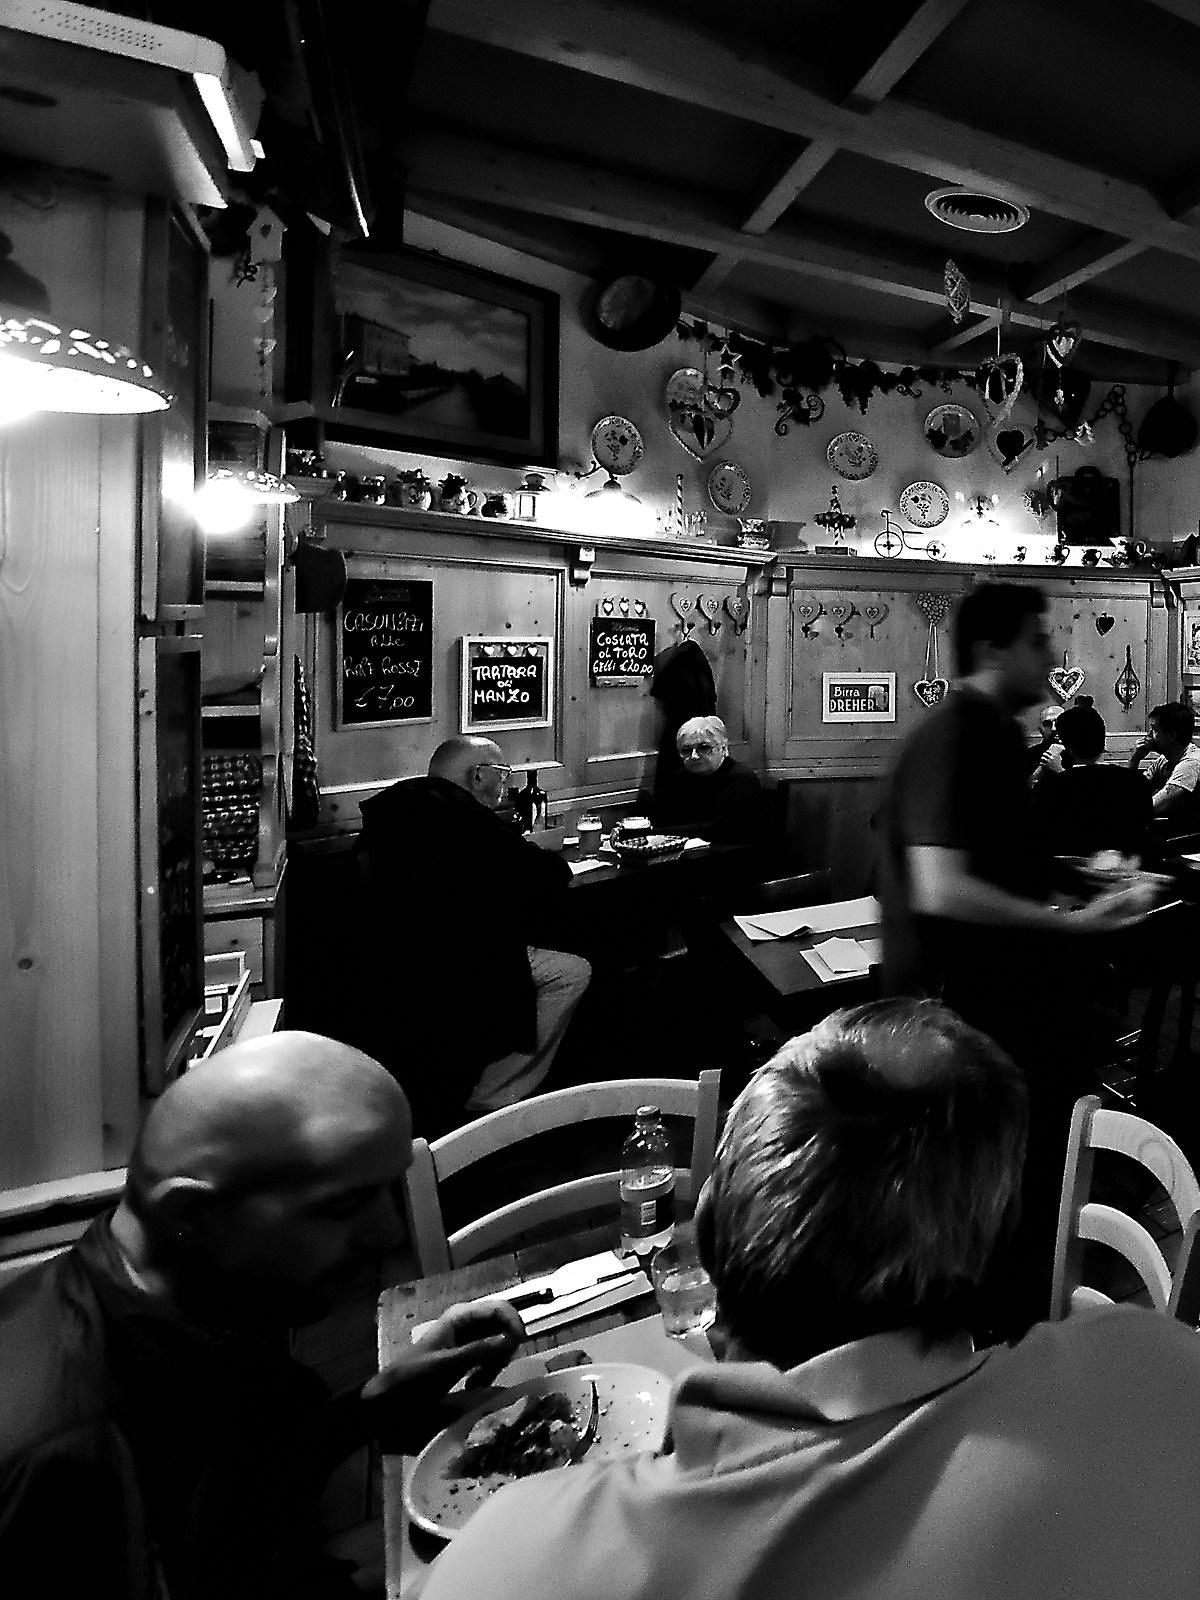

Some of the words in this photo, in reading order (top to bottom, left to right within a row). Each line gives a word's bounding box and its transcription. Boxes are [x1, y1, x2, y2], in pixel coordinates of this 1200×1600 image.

[473, 688, 530, 704] MANZO
[834, 686, 860, 697] Birra
[830, 699, 875, 712] DREHER
